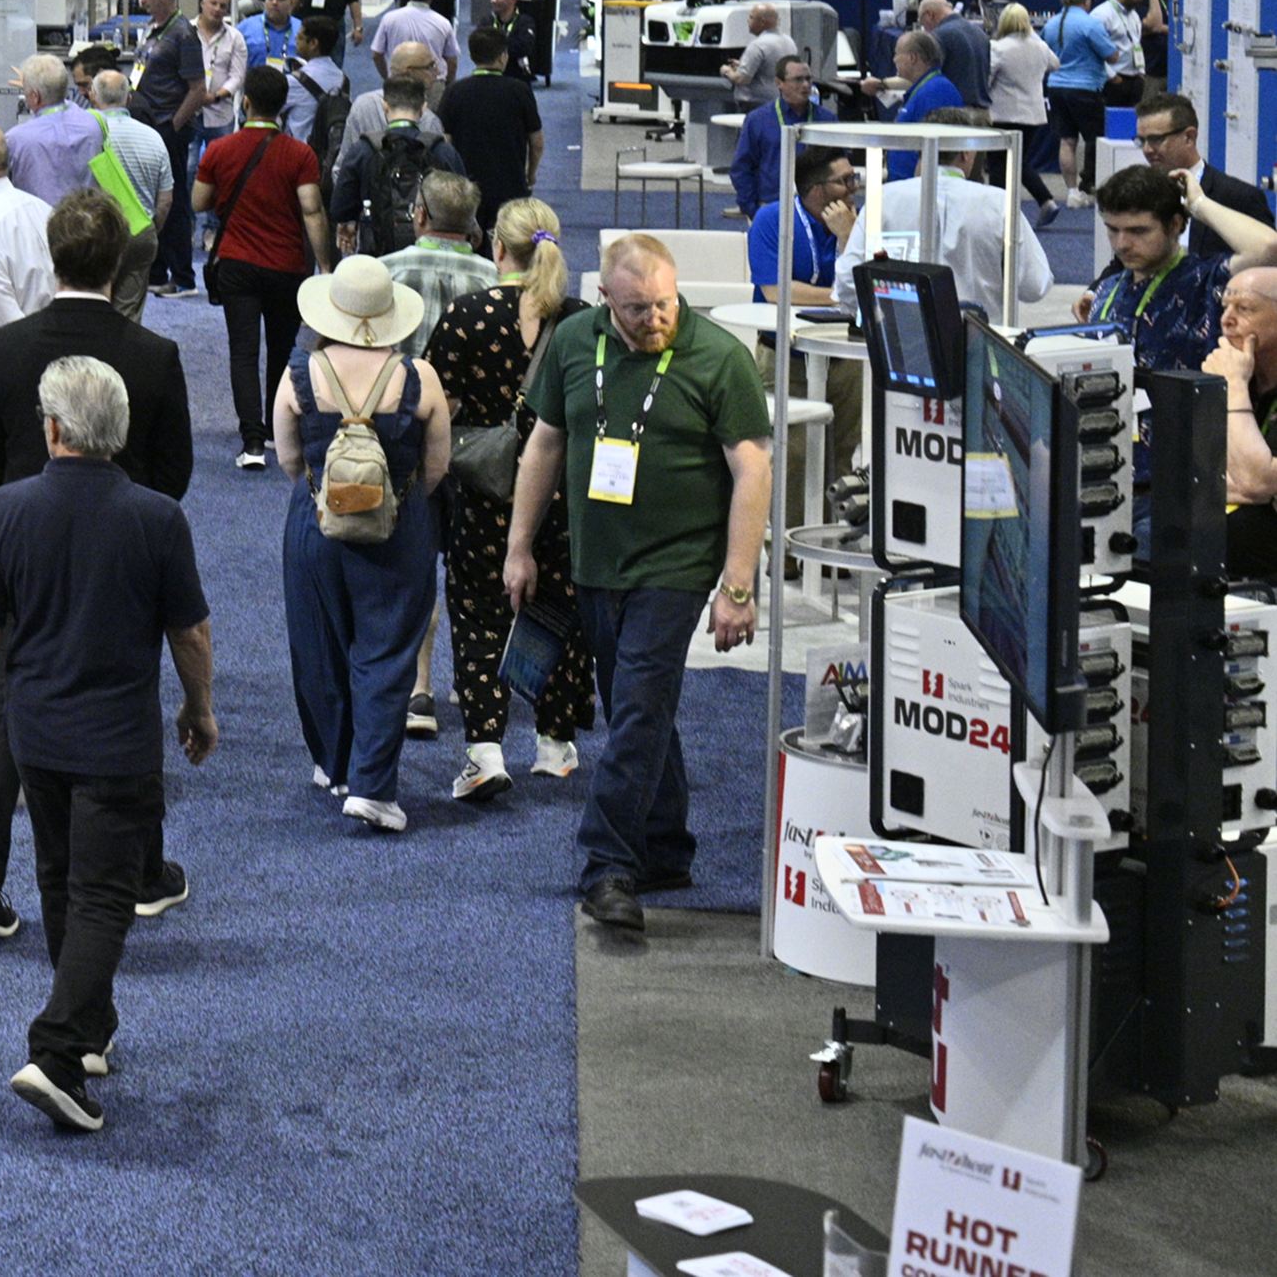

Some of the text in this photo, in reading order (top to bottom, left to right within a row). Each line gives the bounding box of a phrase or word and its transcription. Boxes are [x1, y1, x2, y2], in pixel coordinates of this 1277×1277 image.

[948, 677, 972, 693] Spark
[948, 692, 990, 712] Industries
[895, 696, 1010, 755] MOD24
[905, 1229, 1049, 1277] RUNNE
[945, 1209, 1018, 1254] HOT
